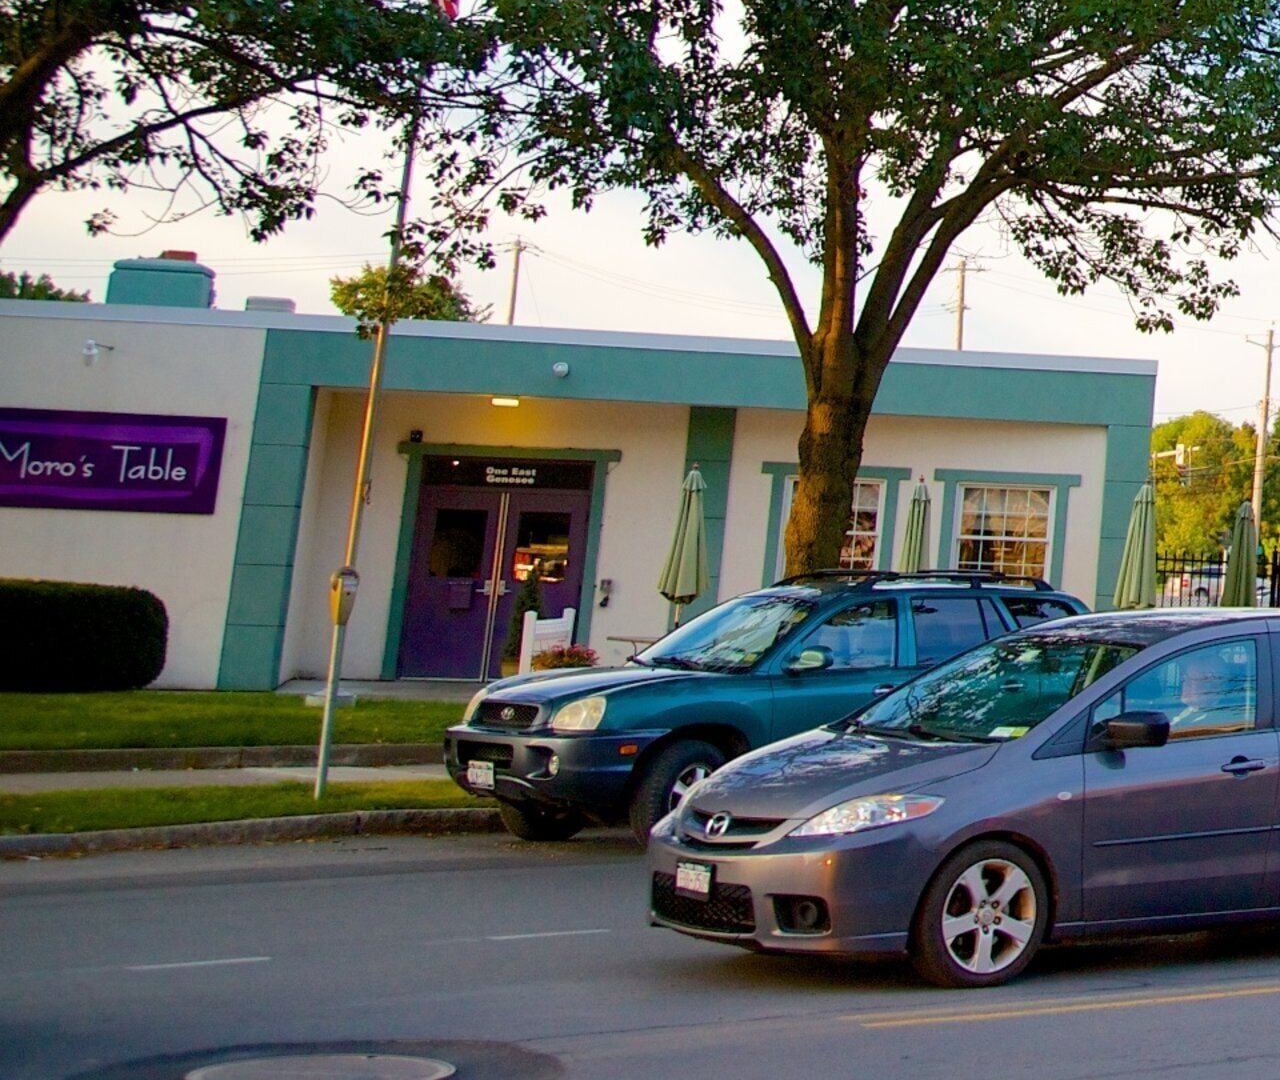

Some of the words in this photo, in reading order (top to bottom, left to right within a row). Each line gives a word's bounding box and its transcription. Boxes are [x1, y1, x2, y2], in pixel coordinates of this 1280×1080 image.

[0, 441, 95, 479] Moro's
[112, 444, 187, 483] Table
[486, 466, 509, 476] One
[511, 467, 537, 477] East
